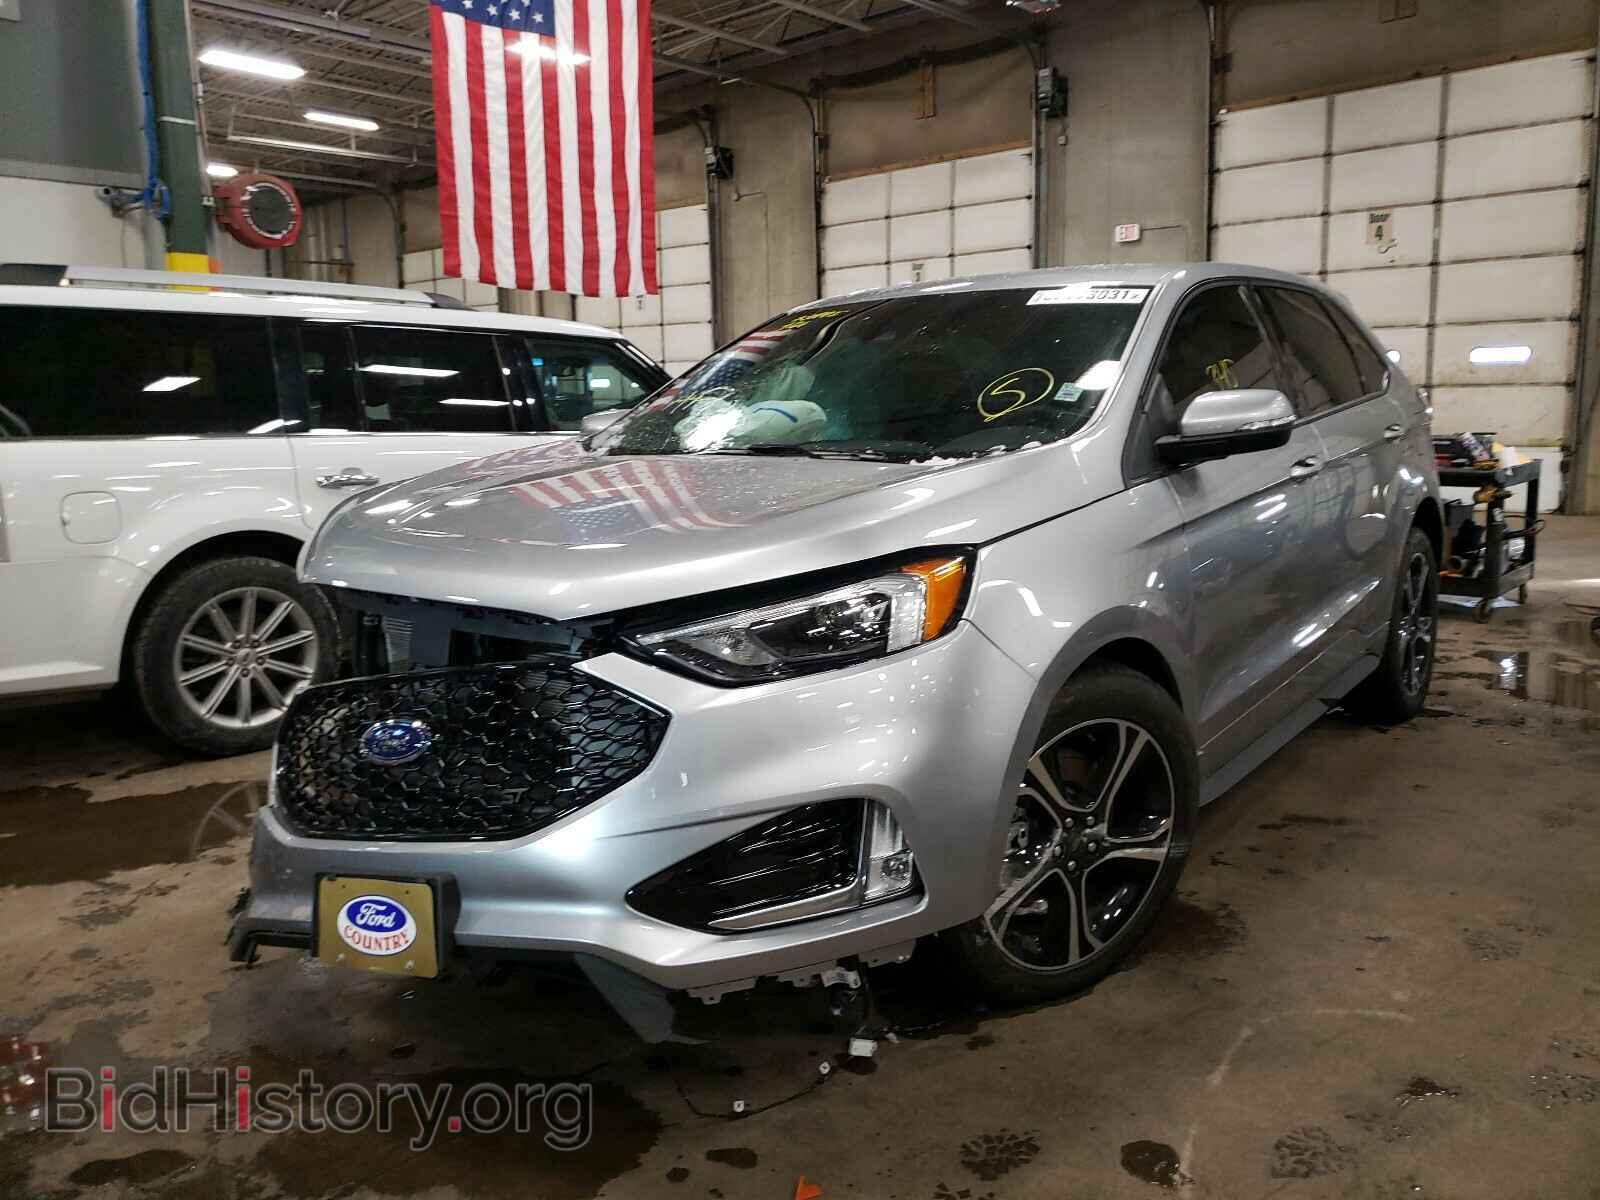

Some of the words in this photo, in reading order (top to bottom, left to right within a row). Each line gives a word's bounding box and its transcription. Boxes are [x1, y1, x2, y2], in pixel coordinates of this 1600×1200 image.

[1375, 225, 1384, 240] 4
[356, 903, 396, 928] Ford
[344, 925, 409, 951] COUNTRY
